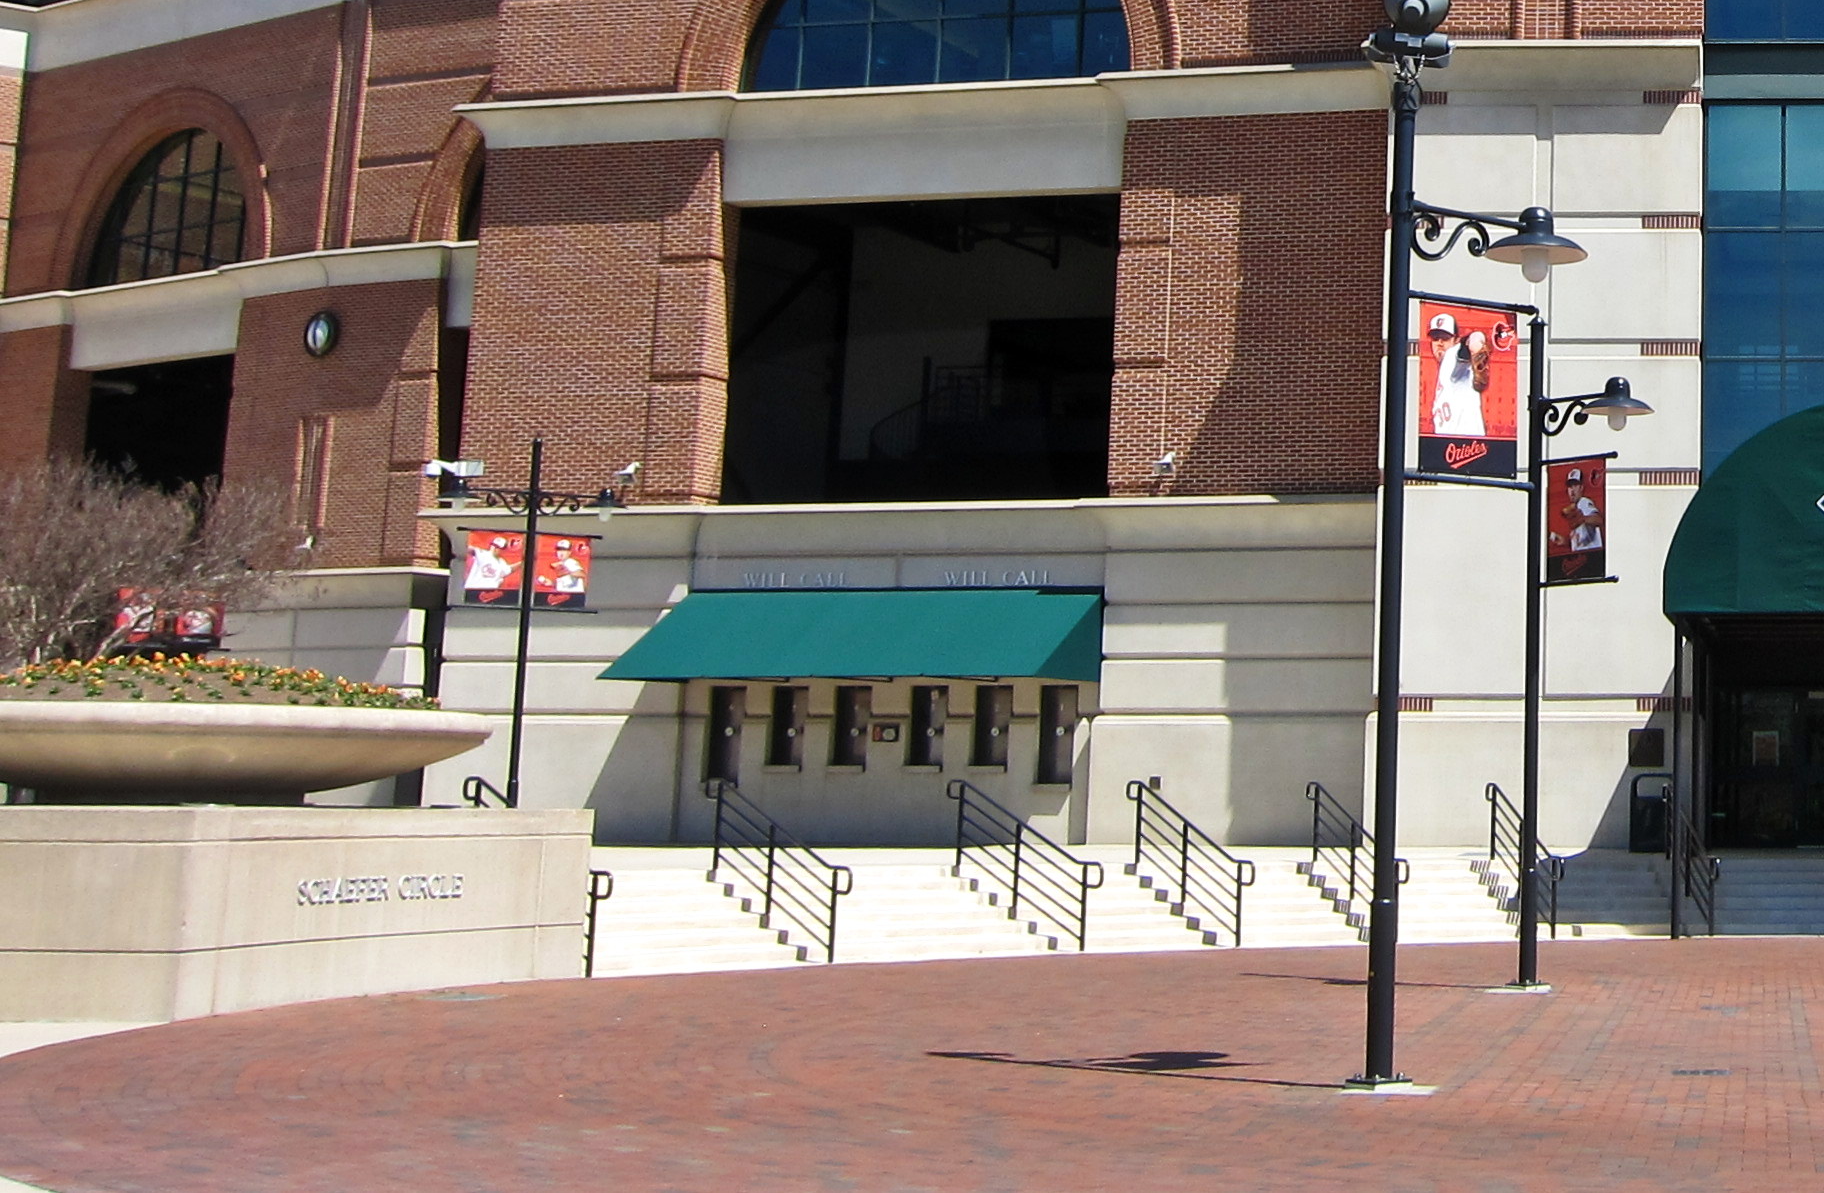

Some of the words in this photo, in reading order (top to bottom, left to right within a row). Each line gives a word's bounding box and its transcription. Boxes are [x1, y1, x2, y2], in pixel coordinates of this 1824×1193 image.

[1445, 441, 1487, 469] Orioles
[743, 572, 789, 588] WILL
[800, 572, 849, 588] CALL
[944, 570, 991, 586] WILL
[1002, 570, 1055, 586] CALL
[296, 875, 390, 907] SCHAEFER
[397, 872, 465, 901] CIRCLE
